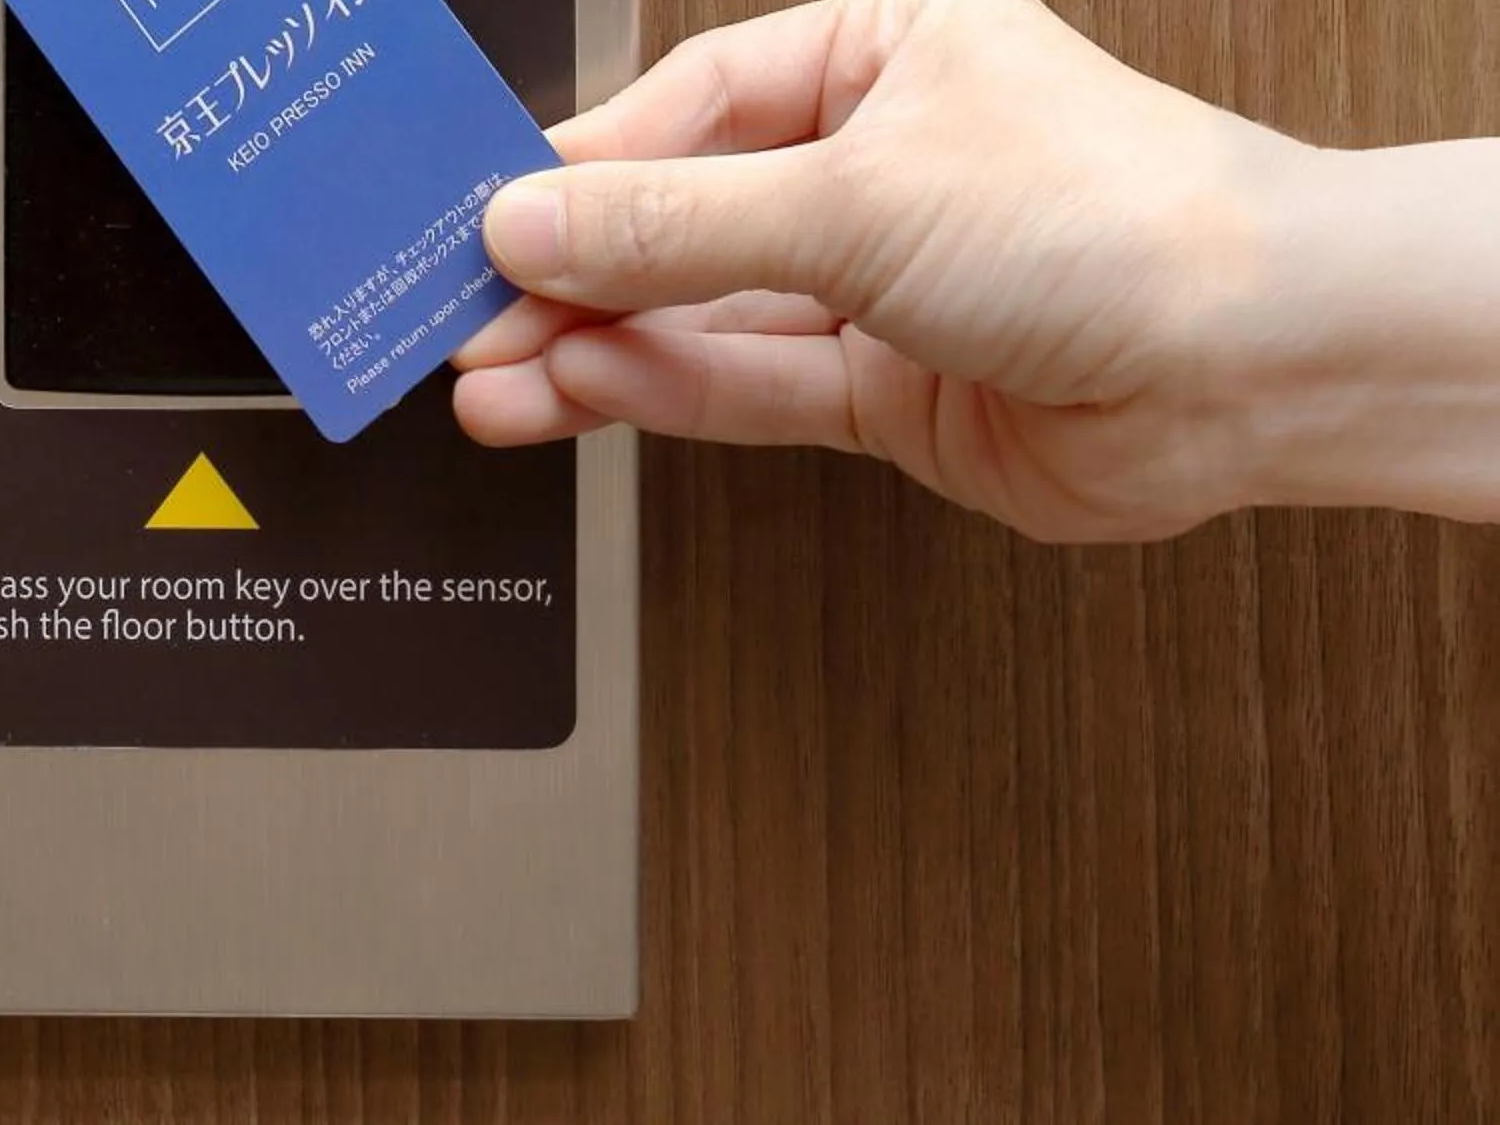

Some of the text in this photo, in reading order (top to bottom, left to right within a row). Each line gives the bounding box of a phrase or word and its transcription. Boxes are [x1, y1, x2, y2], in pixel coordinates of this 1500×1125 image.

[227, 42, 376, 172] KEIO PRESSO INN
[319, 207, 486, 356] フロントまたは回収ボックスまで
[347, 357, 390, 394] Please
[390, 326, 429, 361] return
[428, 298, 460, 328] upon
[39, 608, 92, 640] the
[100, 609, 177, 641] floor
[187, 610, 306, 642] button.
[57, 577, 131, 609] your
[141, 576, 225, 601] room
[235, 568, 291, 608] key
[299, 577, 370, 602] over
[379, 570, 432, 602] the
[442, 578, 552, 606] sensor,
